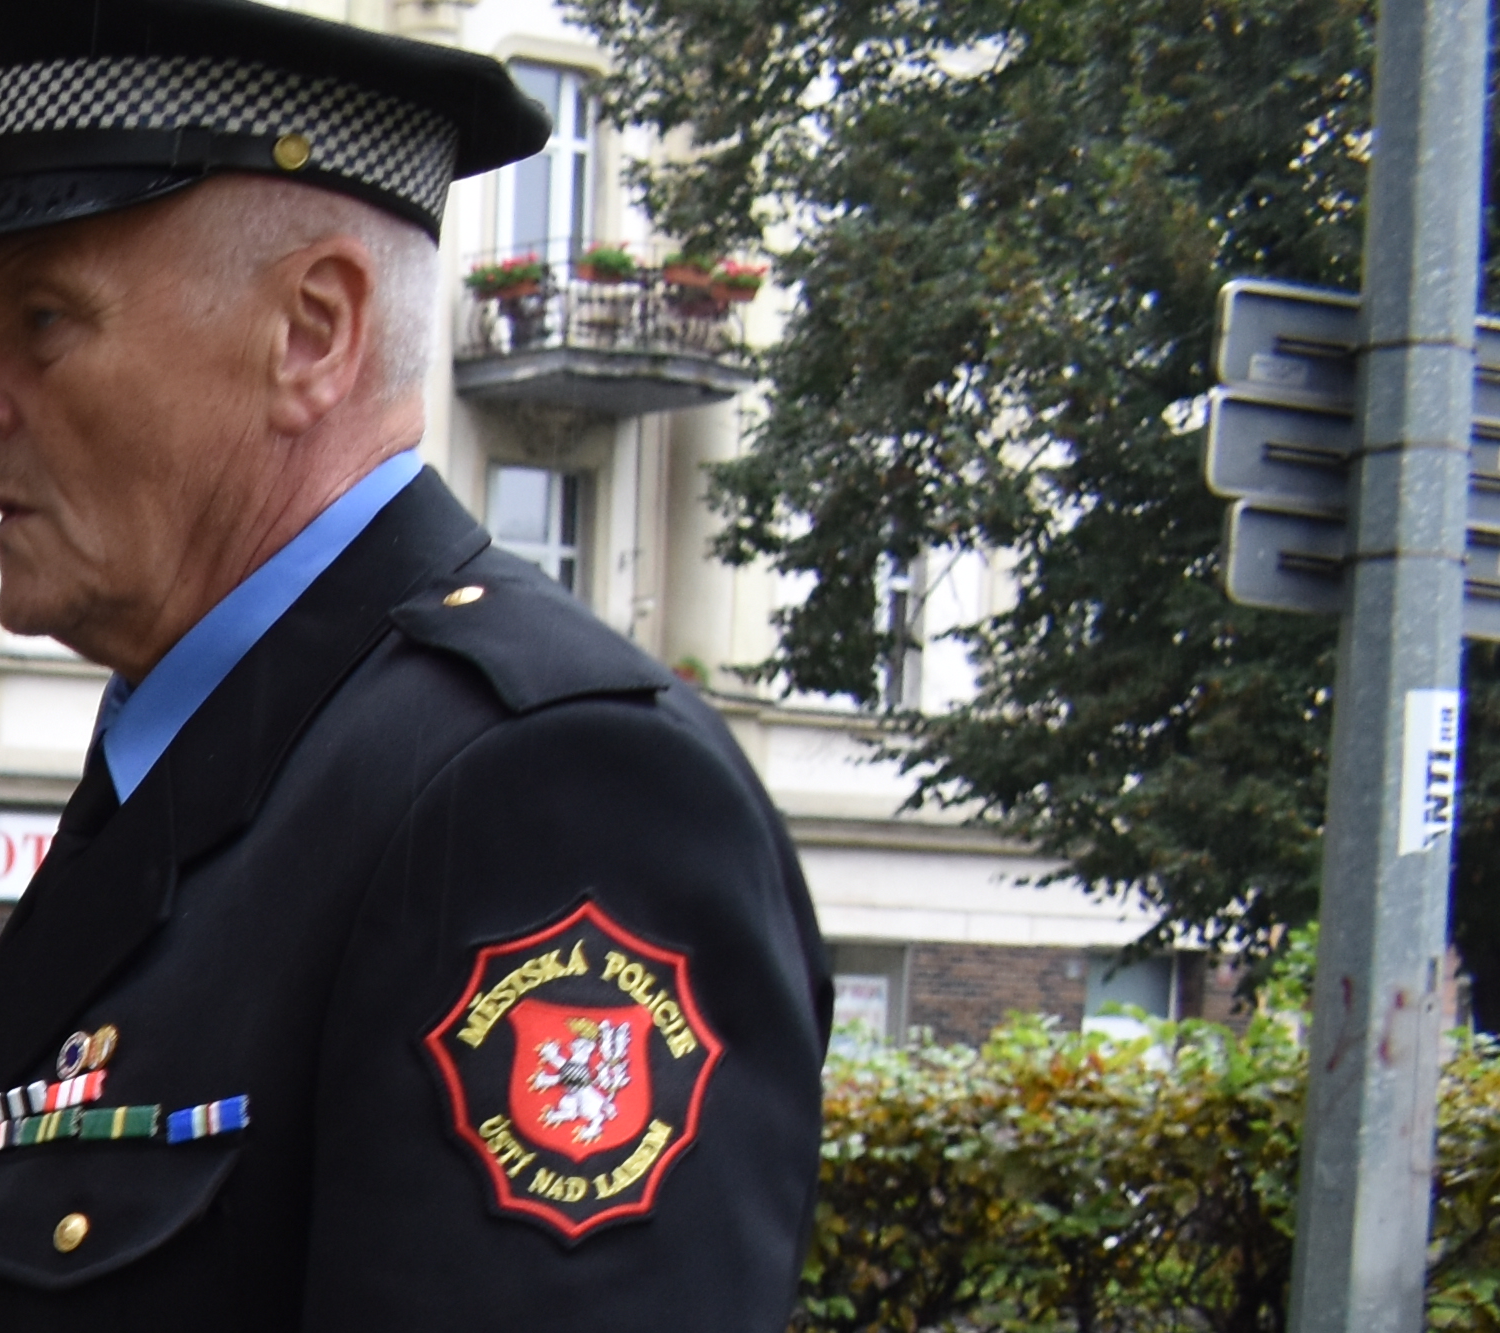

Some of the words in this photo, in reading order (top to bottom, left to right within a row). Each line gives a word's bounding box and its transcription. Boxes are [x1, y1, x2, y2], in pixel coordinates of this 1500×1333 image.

[456, 938, 589, 1049] MĚSTSKÁ
[600, 950, 698, 1060] POLICIE
[479, 1114, 537, 1179] ÚSTÍ
[527, 1167, 588, 1203] NAD
[592, 1118, 673, 1200] LABEM
